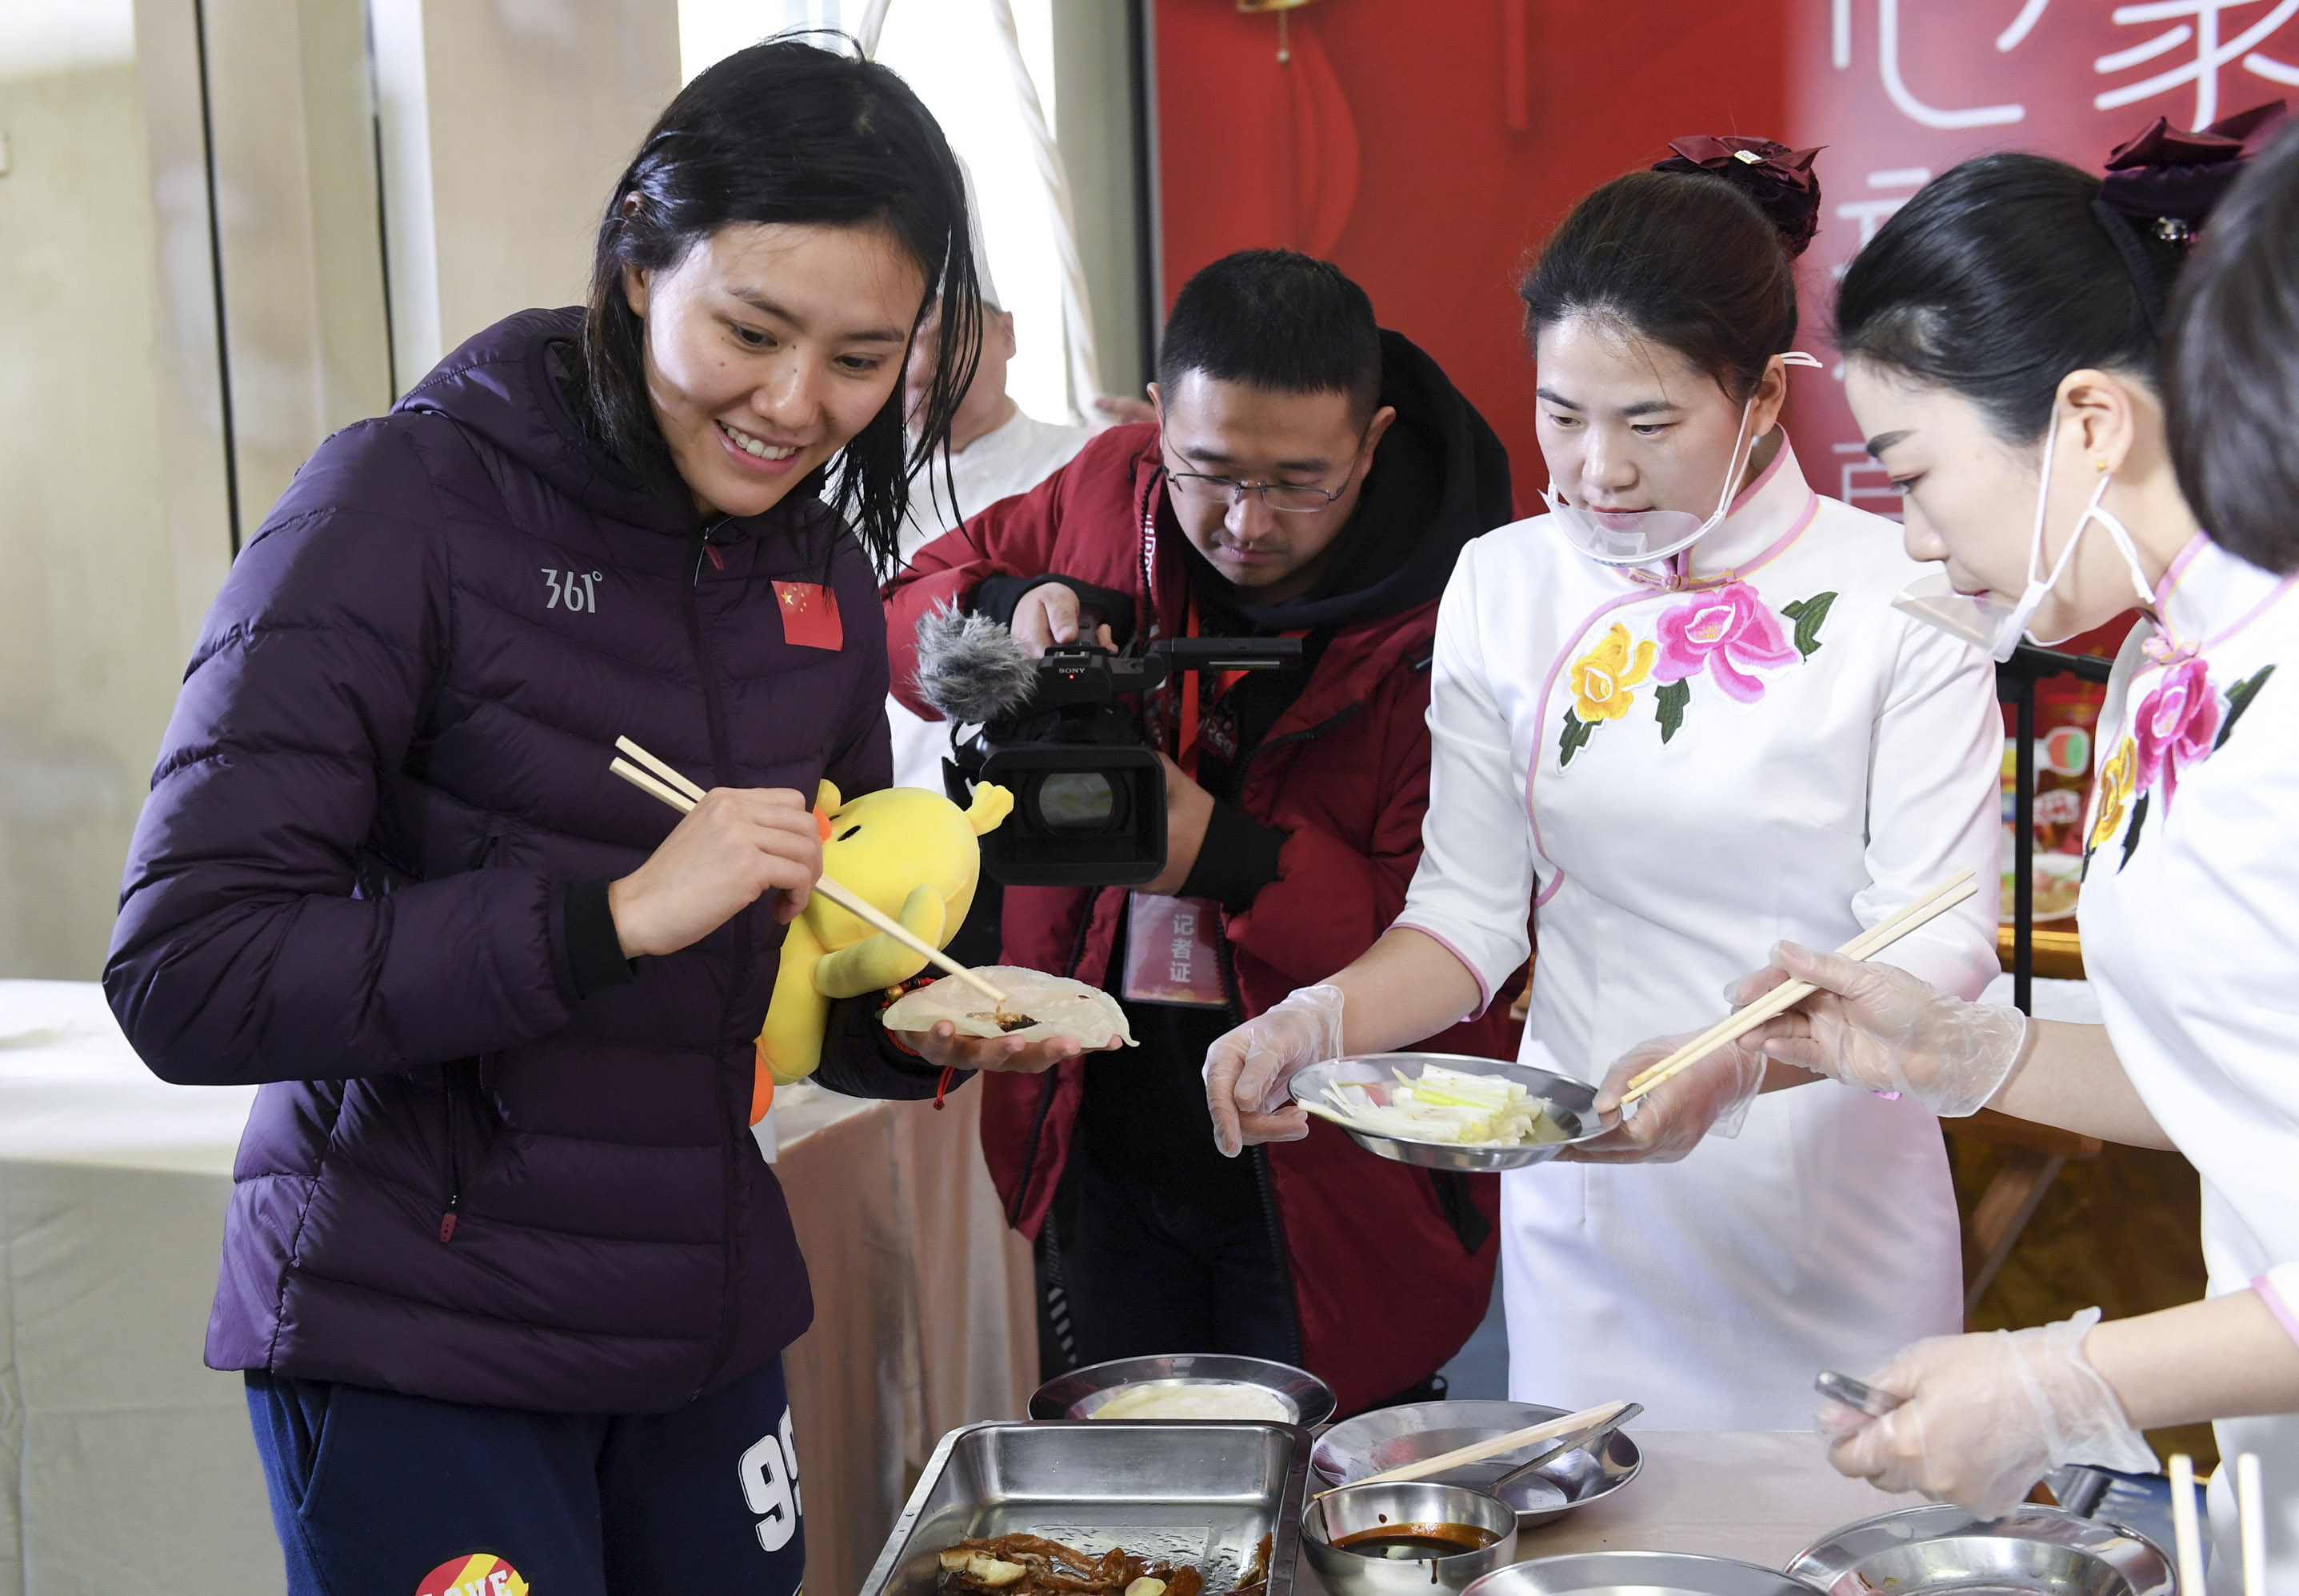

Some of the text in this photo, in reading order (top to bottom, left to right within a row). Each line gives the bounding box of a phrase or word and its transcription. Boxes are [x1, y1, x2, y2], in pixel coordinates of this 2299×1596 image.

[541, 568, 603, 614] 361°
[1169, 914, 1194, 983] 记者证
